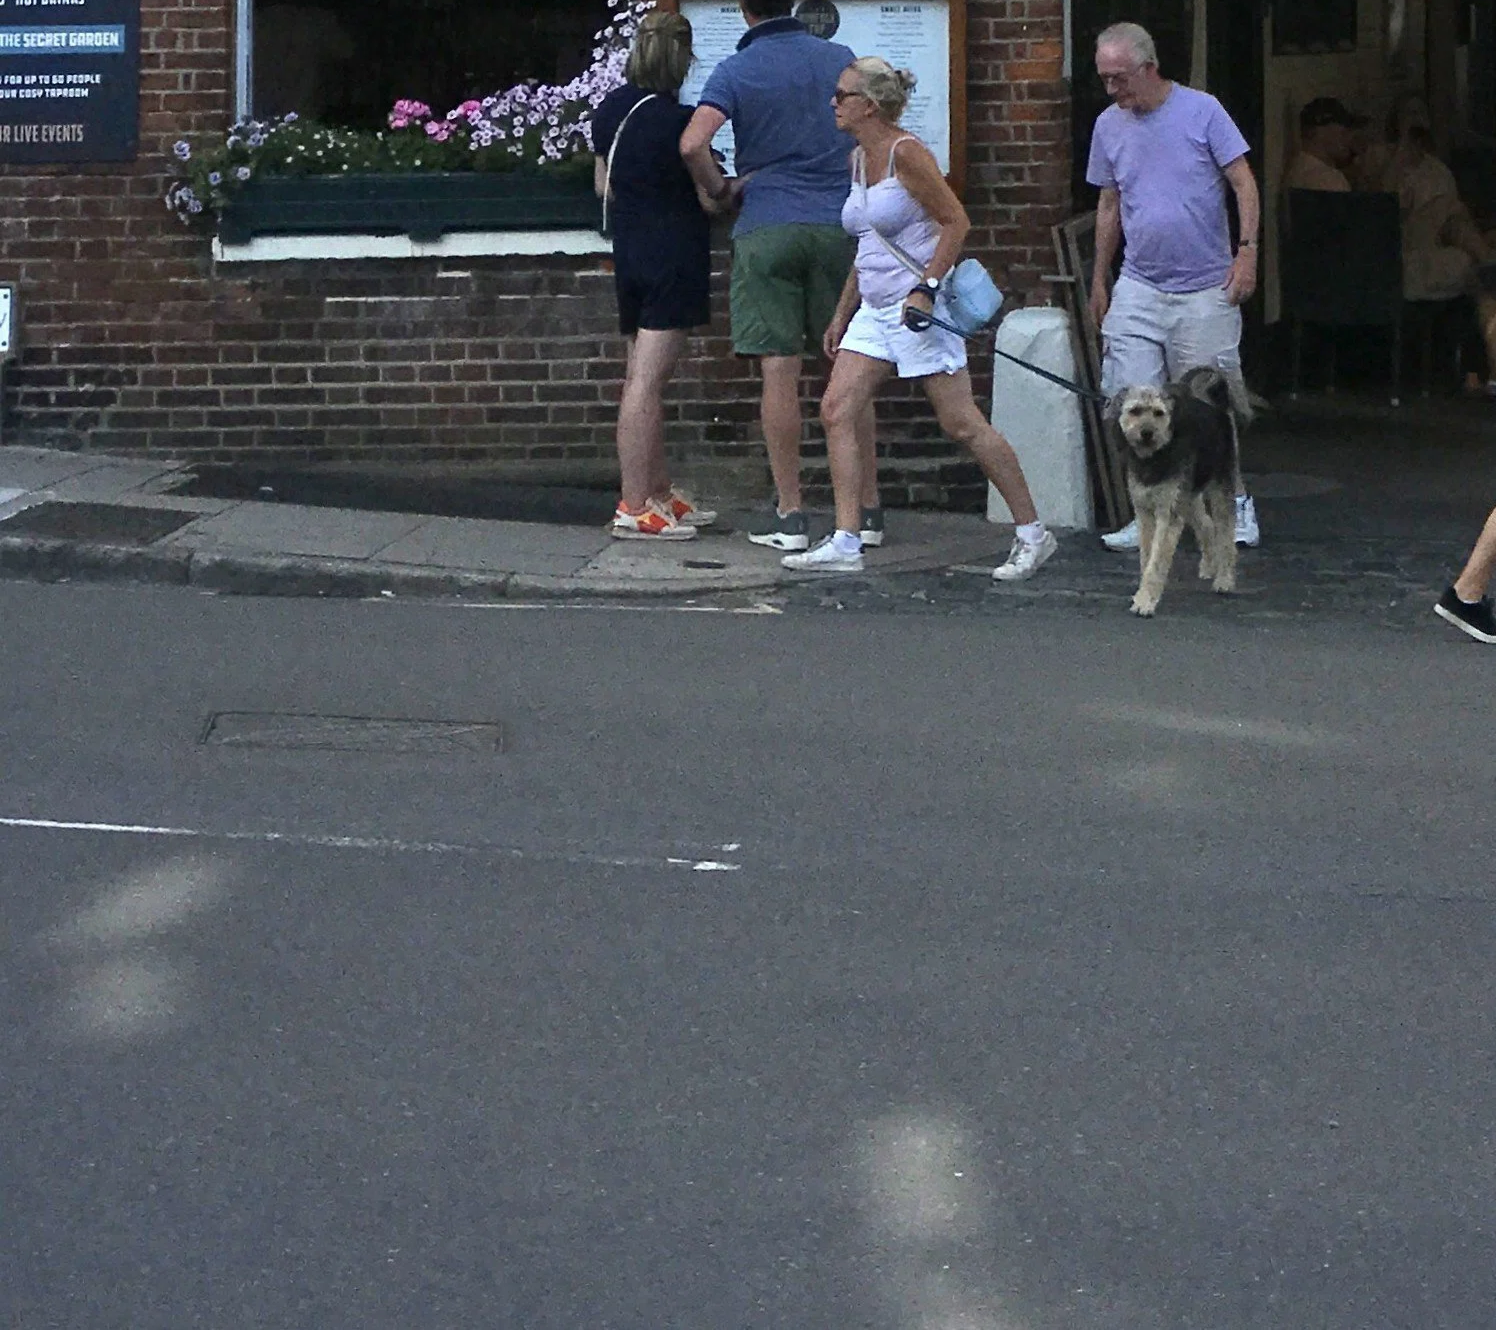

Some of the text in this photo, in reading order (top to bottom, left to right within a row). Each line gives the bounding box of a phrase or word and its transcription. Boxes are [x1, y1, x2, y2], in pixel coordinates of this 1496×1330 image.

[0, 31, 120, 47] THE SECRET GARDEN
[4, 75, 22, 85] FOR
[24, 75, 37, 84] UP
[39, 75, 50, 84] TO
[66, 74, 101, 84] PEOPLE
[19, 89, 43, 98] COSY
[45, 87, 89, 98] TAPROOM
[14, 125, 39, 142] LIVE
[41, 124, 84, 142] EVENTS
